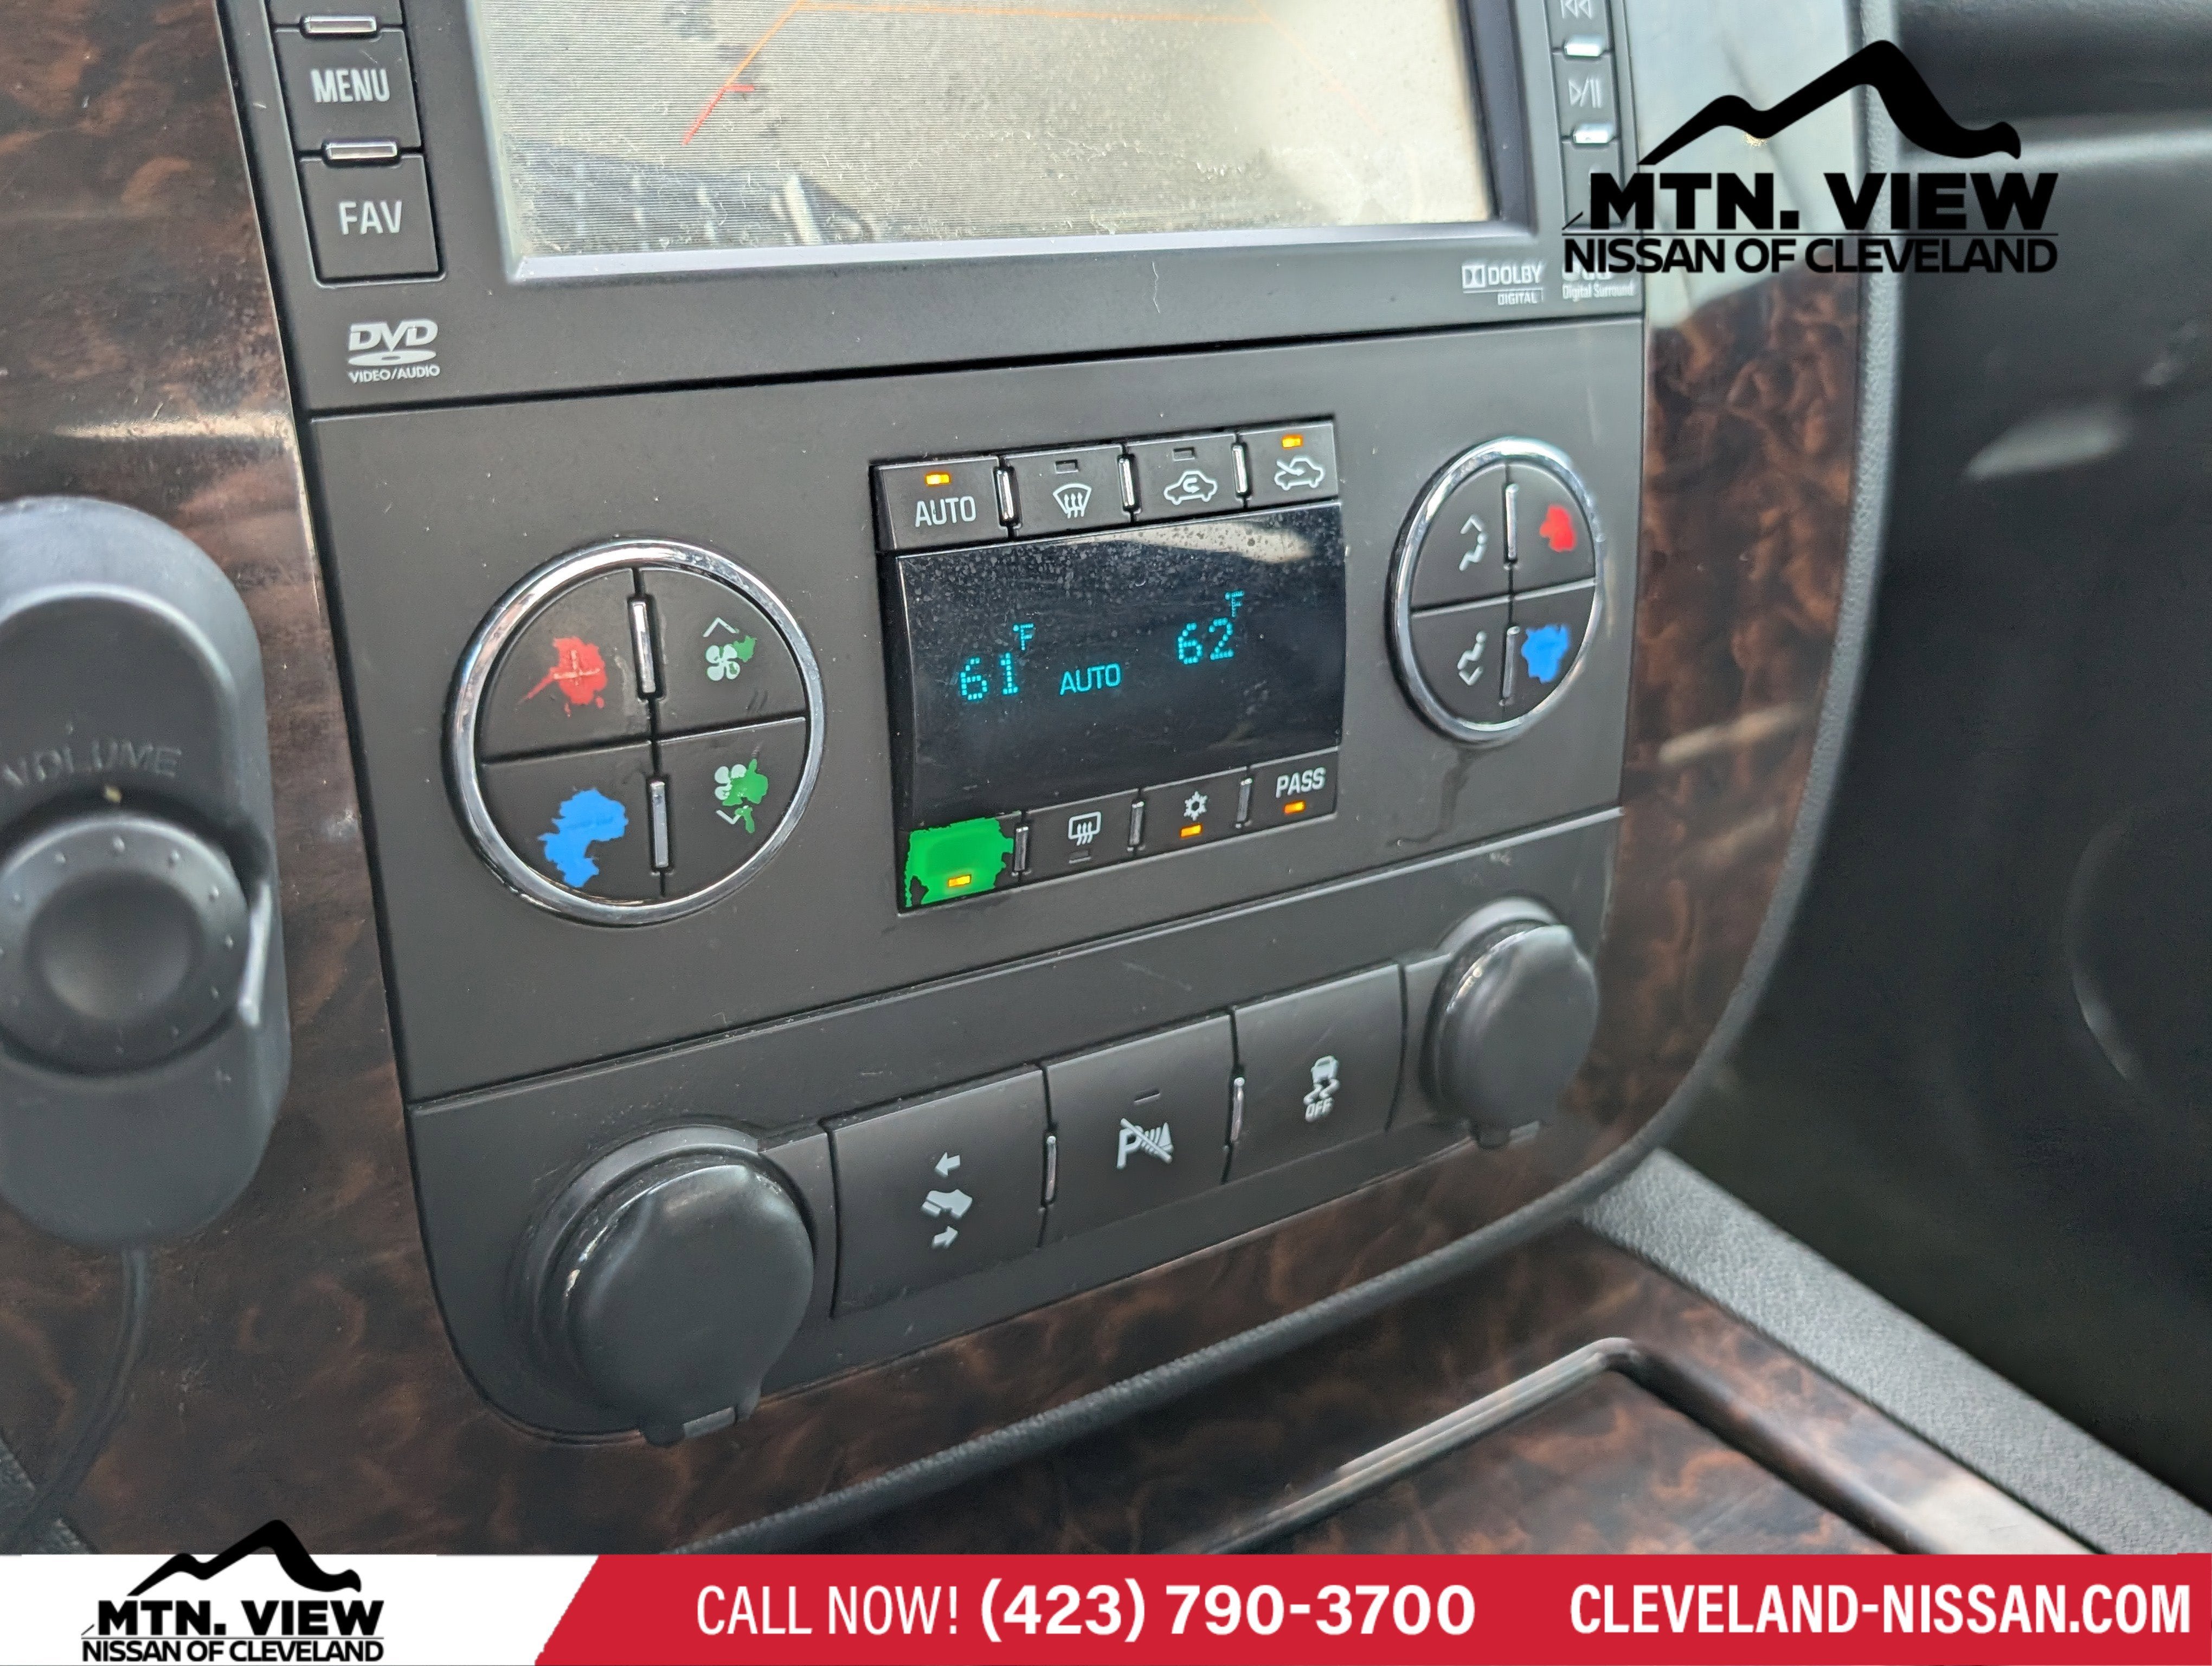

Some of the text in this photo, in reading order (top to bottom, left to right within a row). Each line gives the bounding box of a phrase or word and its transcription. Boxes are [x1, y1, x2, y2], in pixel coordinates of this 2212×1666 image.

[310, 68, 390, 103] MENU
[338, 201, 402, 236] FAV
[1488, 264, 1542, 285] DOLBY
[1562, 278, 1634, 302] Digital Surround
[1497, 292, 1539, 305] DIGITAL
[348, 318, 438, 351] DVD
[348, 364, 441, 384] VIDEO/AUDIO
[915, 495, 976, 528] AUTO
[1176, 617, 1234, 665] 62
[960, 652, 1019, 701] 61
[1059, 663, 1122, 696] AUTO
[1, 740, 182, 786] VOLUME
[1276, 766, 1326, 798] PASS
[1304, 1098, 1332, 1121] OFF
